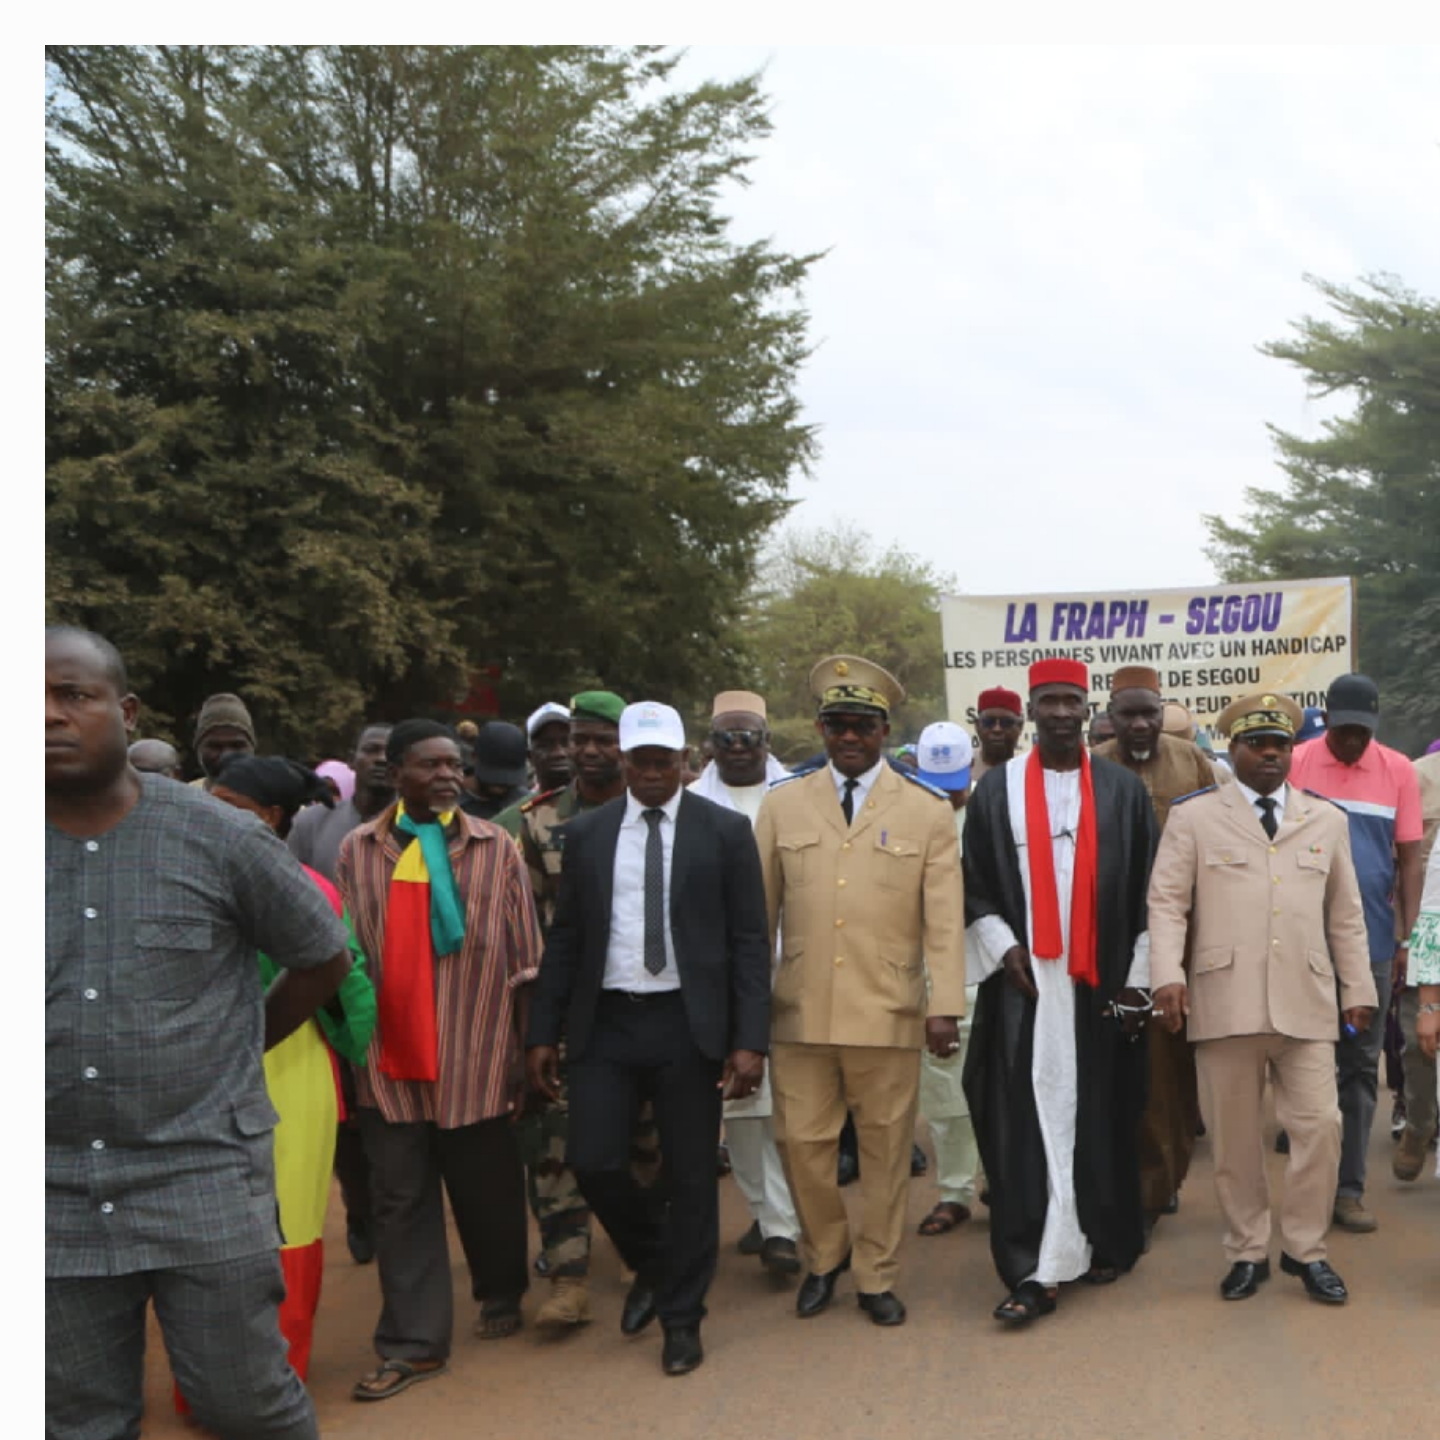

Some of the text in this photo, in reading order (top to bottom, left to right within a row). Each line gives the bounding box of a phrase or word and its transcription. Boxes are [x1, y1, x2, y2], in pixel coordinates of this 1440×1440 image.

[1004, 602, 1037, 643] LA
[1050, 600, 1149, 641] FRAPH
[1185, 592, 1283, 635] SEGOU
[944, 636, 1347, 669] LES PERSONNES VIVANT AVEC UN HANDICAP
[1169, 670, 1193, 687] DE
[1197, 667, 1260, 685] SEGOU
